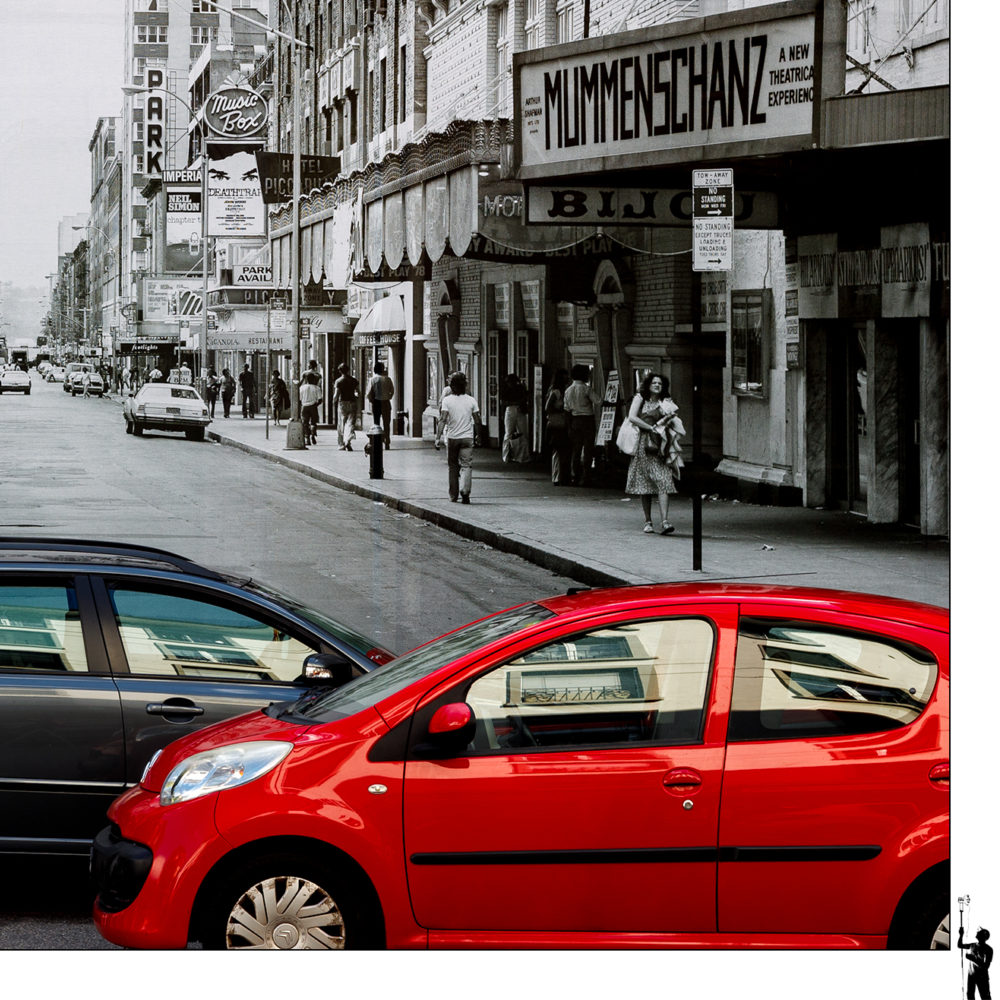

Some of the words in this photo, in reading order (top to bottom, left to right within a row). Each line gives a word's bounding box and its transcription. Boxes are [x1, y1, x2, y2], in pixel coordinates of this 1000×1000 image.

[779, 47, 787, 62] A
[789, 43, 810, 62] NEW
[543, 34, 768, 150] MUMMENSCHANZ
[211, 93, 259, 114] Music
[147, 69, 163, 174] PARK
[219, 110, 262, 132] Box
[282, 160, 323, 173] HTEL
[163, 170, 202, 182] IMPERIA
[708, 187, 718, 195] NO
[168, 194, 192, 203] NEIL
[701, 195, 726, 203] STANDING
[168, 202, 200, 211] SIMON
[705, 222, 731, 231] STANDING
[379, 334, 400, 343] HOUSE
